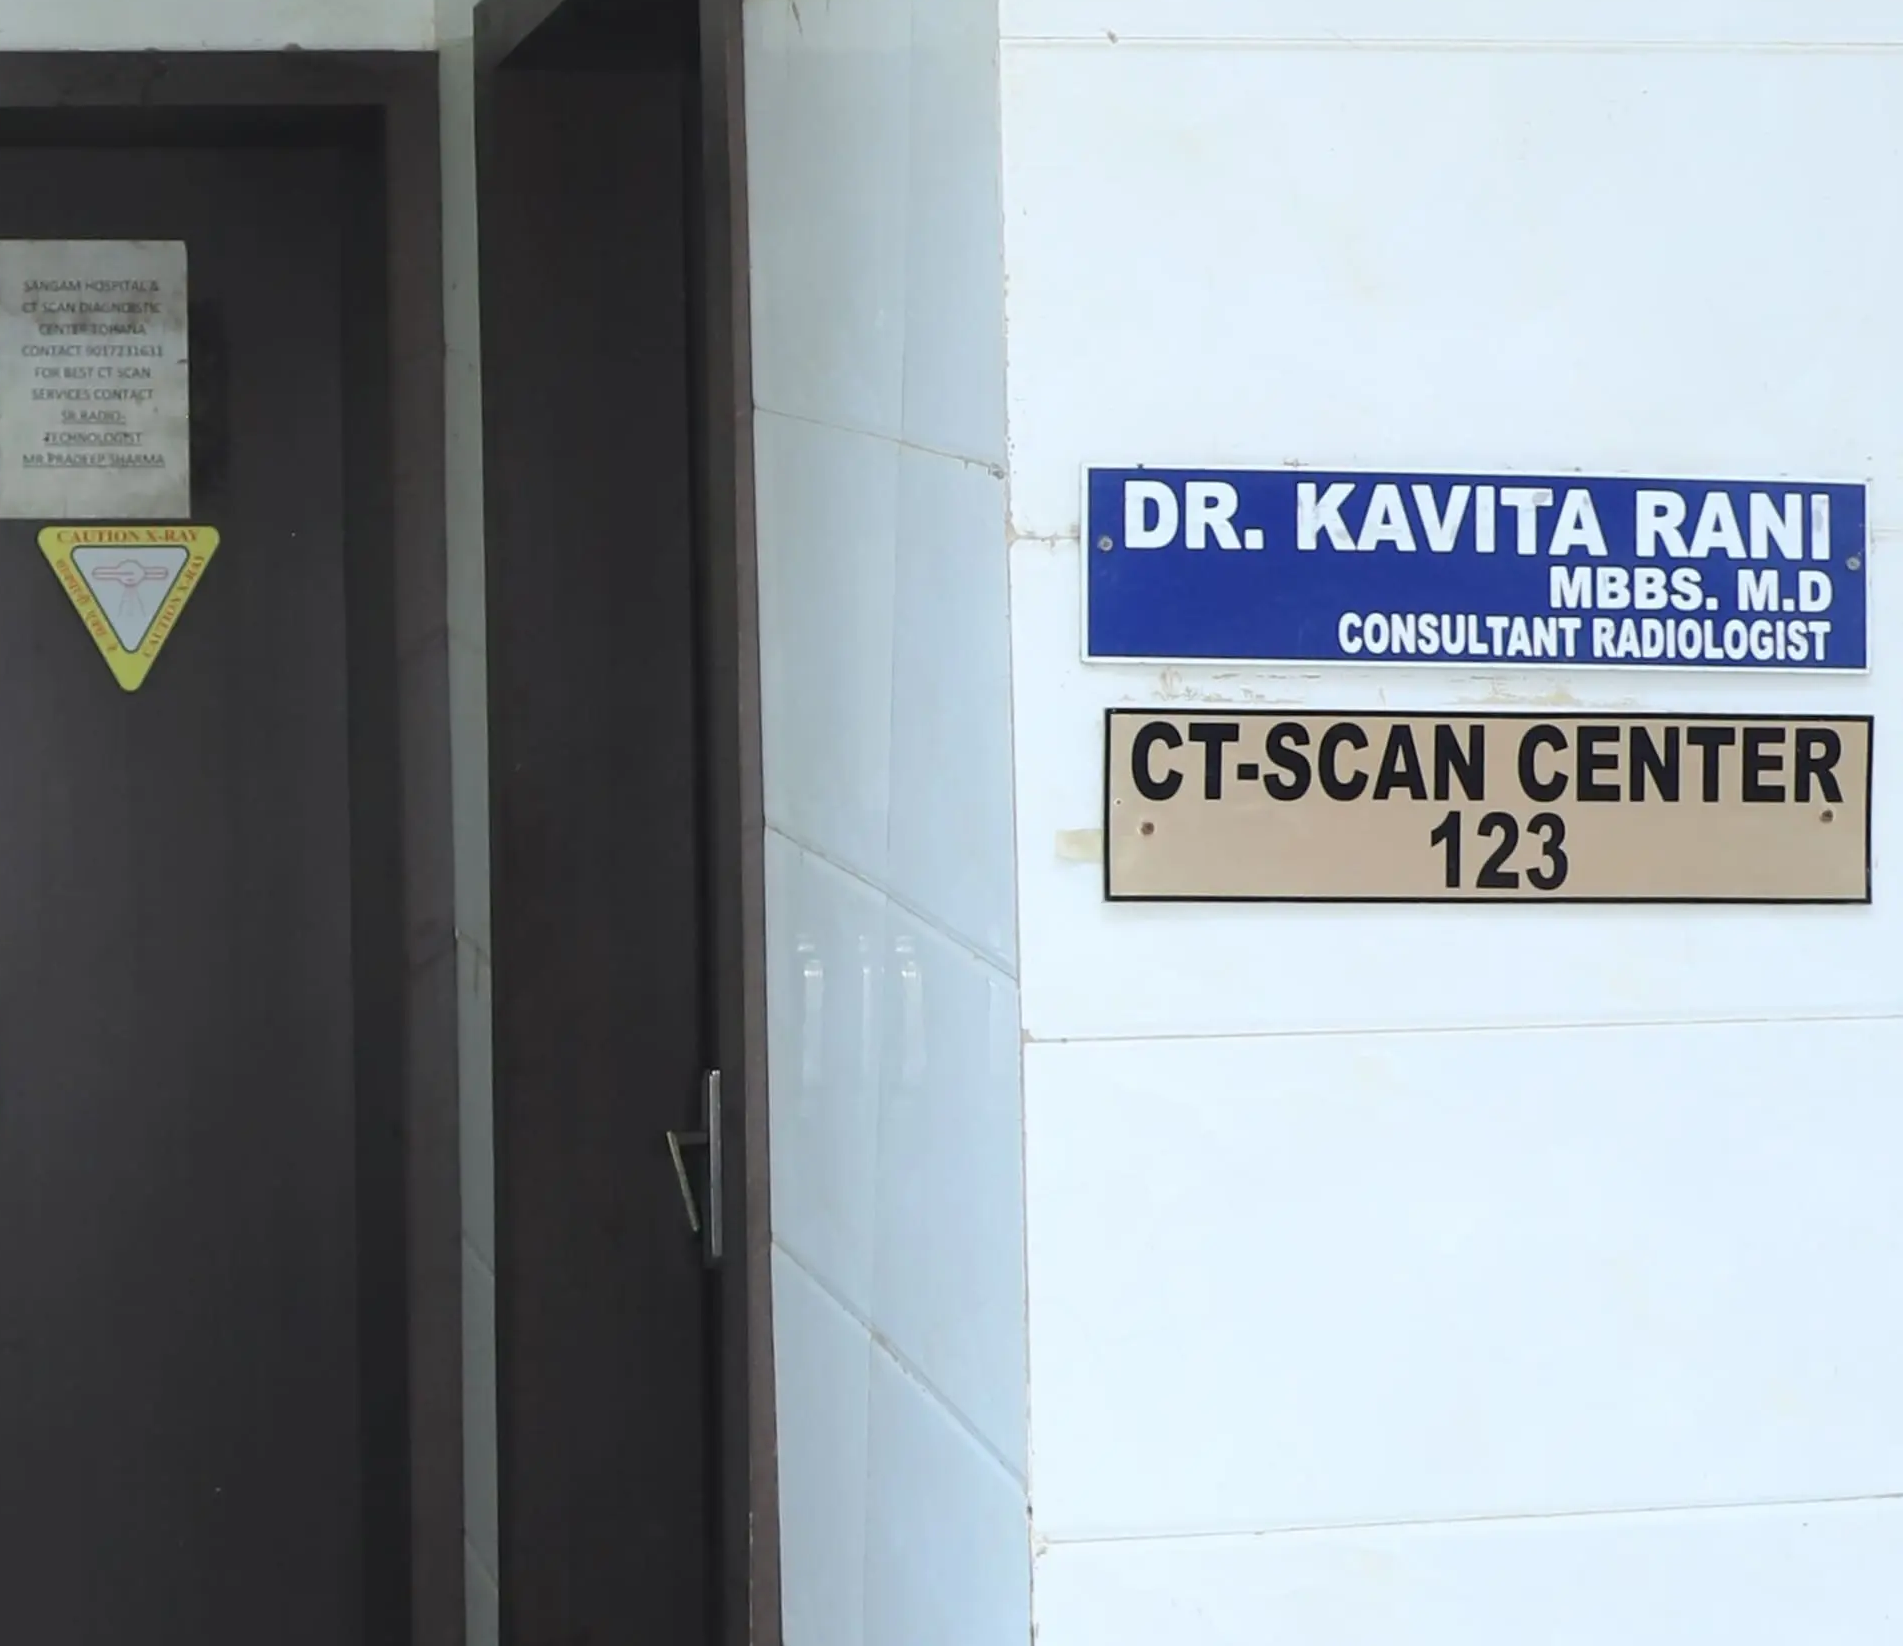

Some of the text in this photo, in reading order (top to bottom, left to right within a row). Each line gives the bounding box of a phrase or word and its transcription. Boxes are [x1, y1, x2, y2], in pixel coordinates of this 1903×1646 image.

[24, 280, 81, 291] SANGAM
[86, 280, 147, 291] HOSPITAL
[22, 302, 37, 313] CT
[42, 302, 75, 313] SCAN
[22, 345, 81, 357] CONTACT
[35, 367, 151, 378] FOR BEST CT SCAN
[32, 388, 154, 400] SERVICES CONTACT
[111, 453, 166, 465] SHARMA
[1122, 480, 1831, 560] DR. KAVITA RANI
[56, 529, 199, 544] CAUTION X-RAY
[1549, 566, 1832, 613] MBBS. M.D
[1338, 613, 1831, 662] CONSULTANT RADIOLOGIST
[1131, 721, 1844, 804] CT-SCAN CENTER
[1430, 810, 1569, 891] 123
